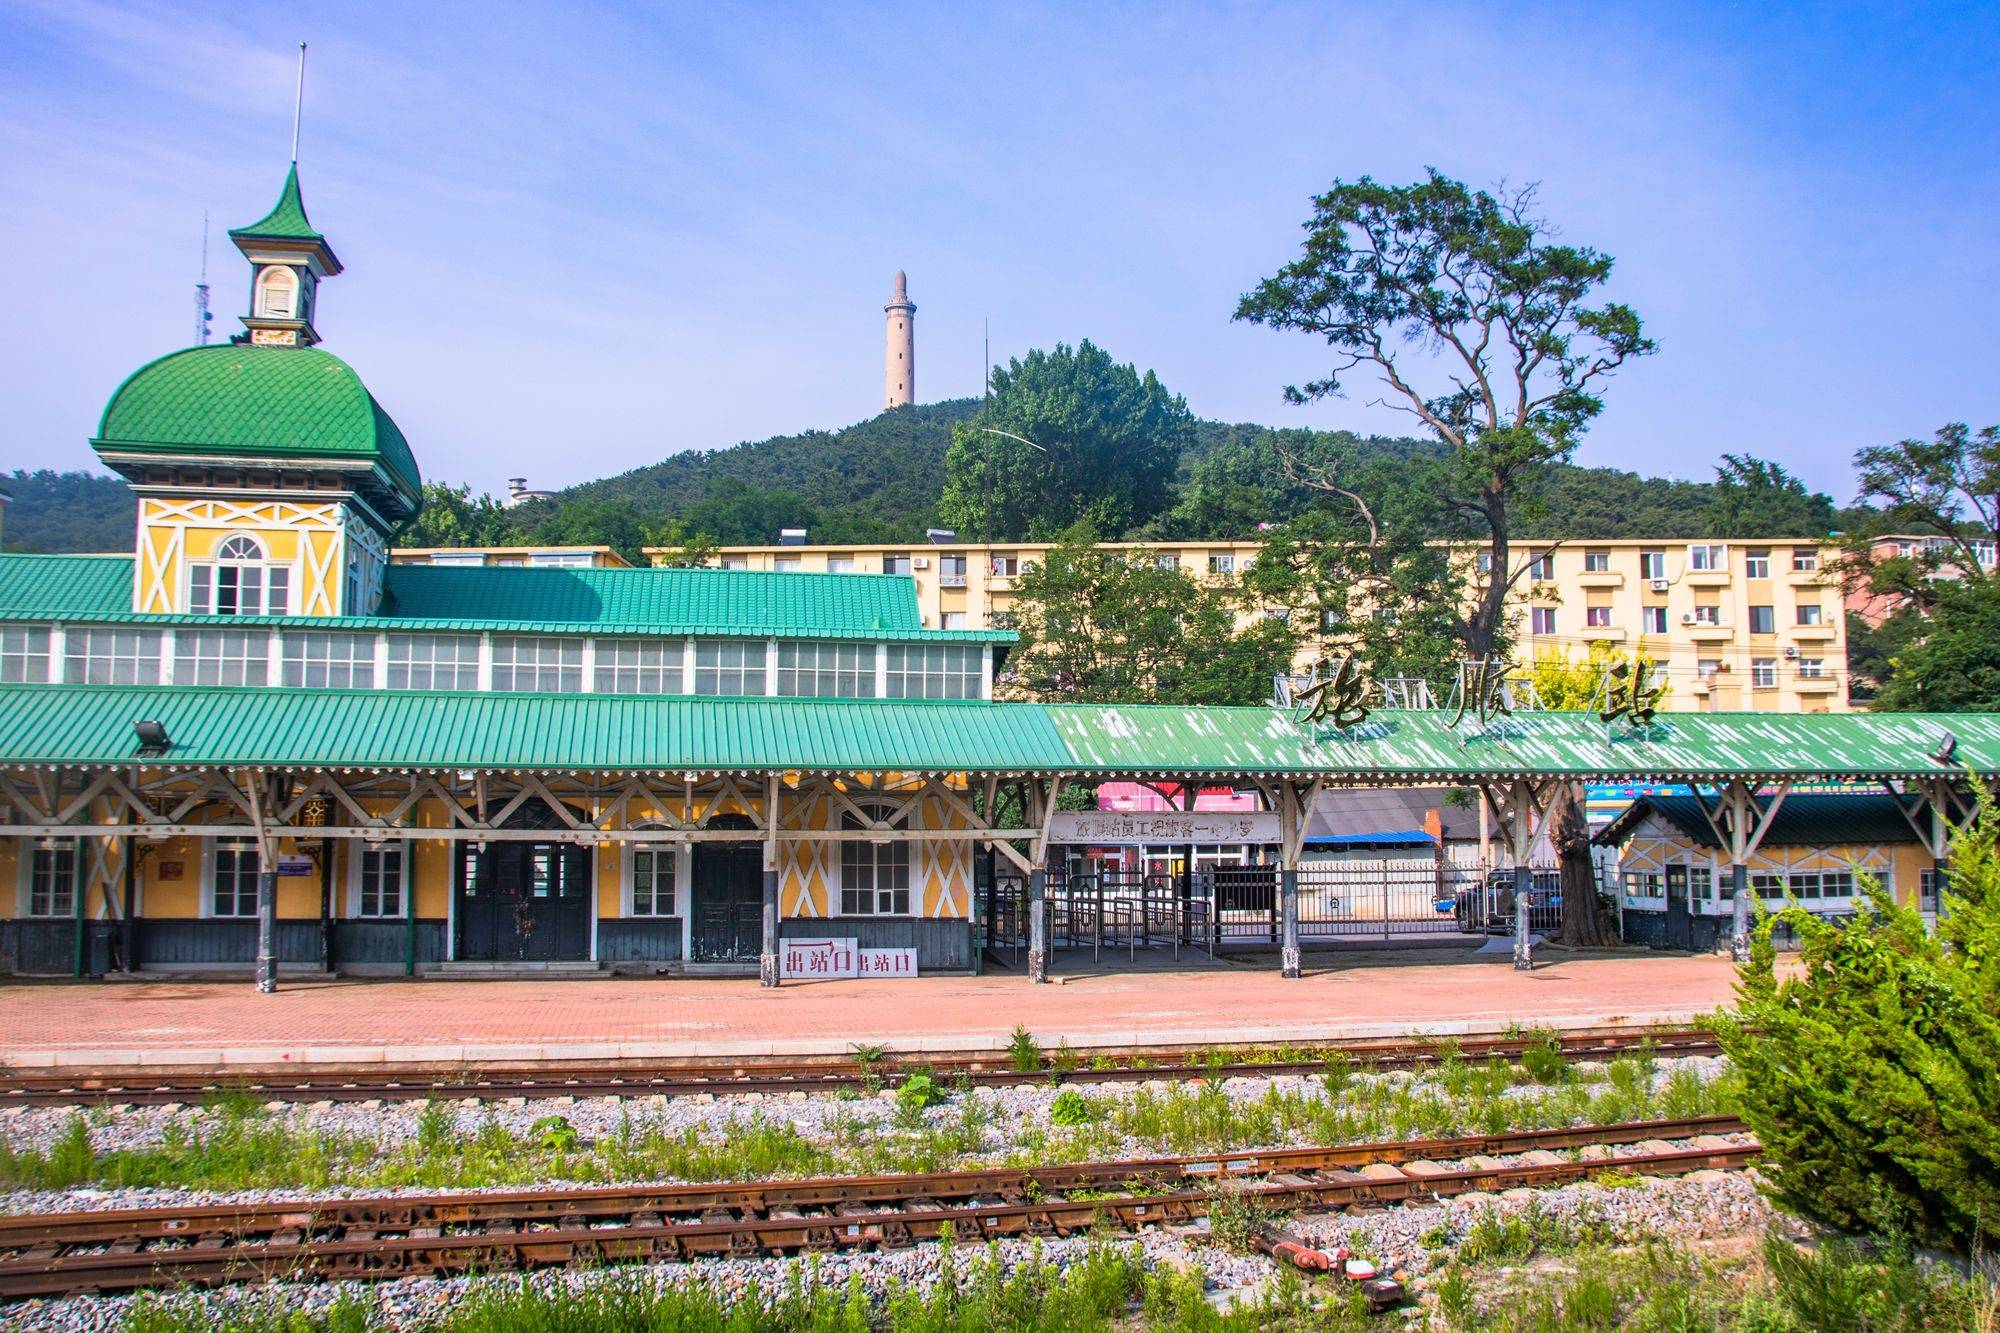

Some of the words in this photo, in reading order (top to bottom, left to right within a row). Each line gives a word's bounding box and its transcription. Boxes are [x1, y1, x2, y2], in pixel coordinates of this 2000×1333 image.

[1294, 653, 1659, 730] 旅顺站
[786, 950, 851, 973] 出站口
[857, 953, 910, 972] 出站口
